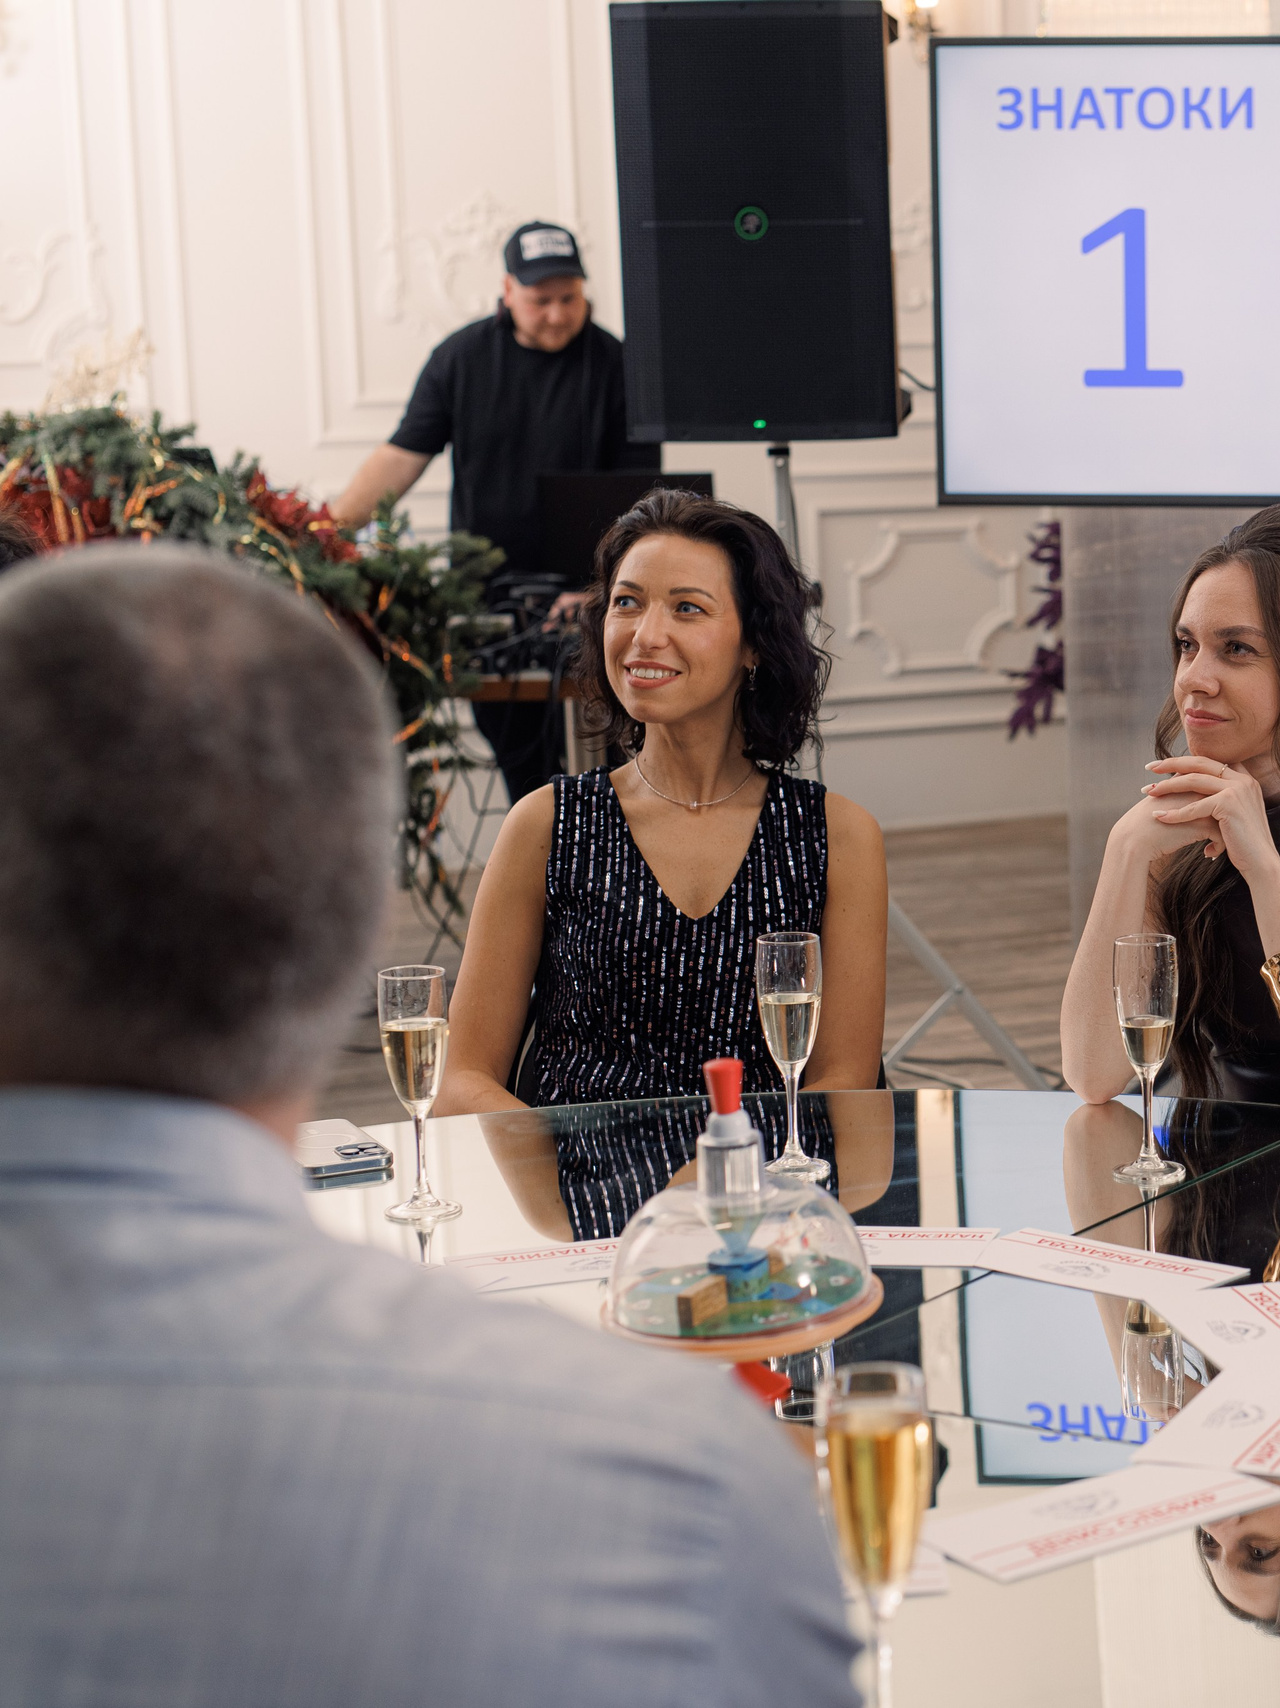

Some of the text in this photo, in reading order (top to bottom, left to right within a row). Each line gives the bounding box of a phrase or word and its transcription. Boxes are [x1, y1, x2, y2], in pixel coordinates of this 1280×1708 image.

[996, 86, 1256, 131] ЗНАТОКИ
[1080, 207, 1185, 388] 1
[886, 1231, 985, 1240] НАДЕЖДА
[492, 1245, 587, 1265] ЛАРИНА
[1036, 1238, 1200, 1273] АННА РЫБАКОВА
